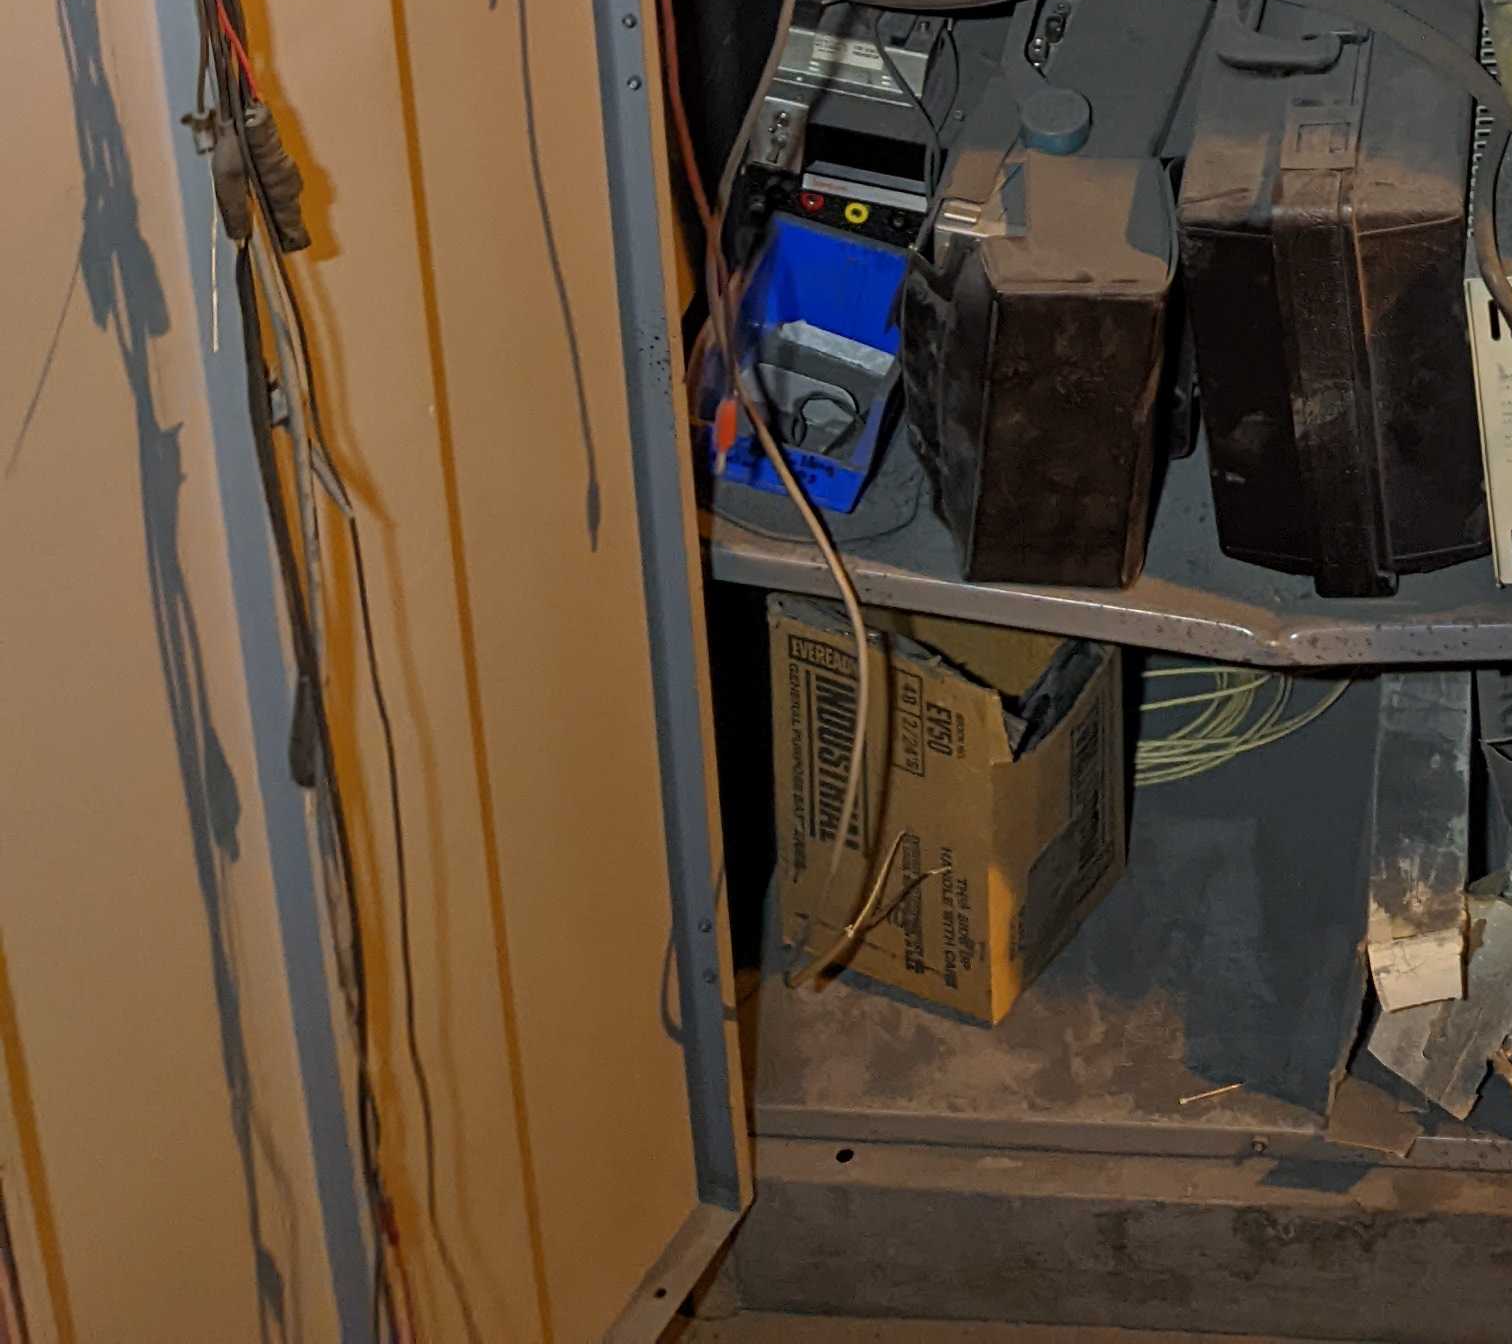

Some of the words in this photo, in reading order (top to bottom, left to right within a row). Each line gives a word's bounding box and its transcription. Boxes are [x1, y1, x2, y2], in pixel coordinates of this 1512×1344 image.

[791, 637, 859, 677] EVEREAD
[926, 701, 954, 757] EV50
[943, 910, 956, 947] WITH
